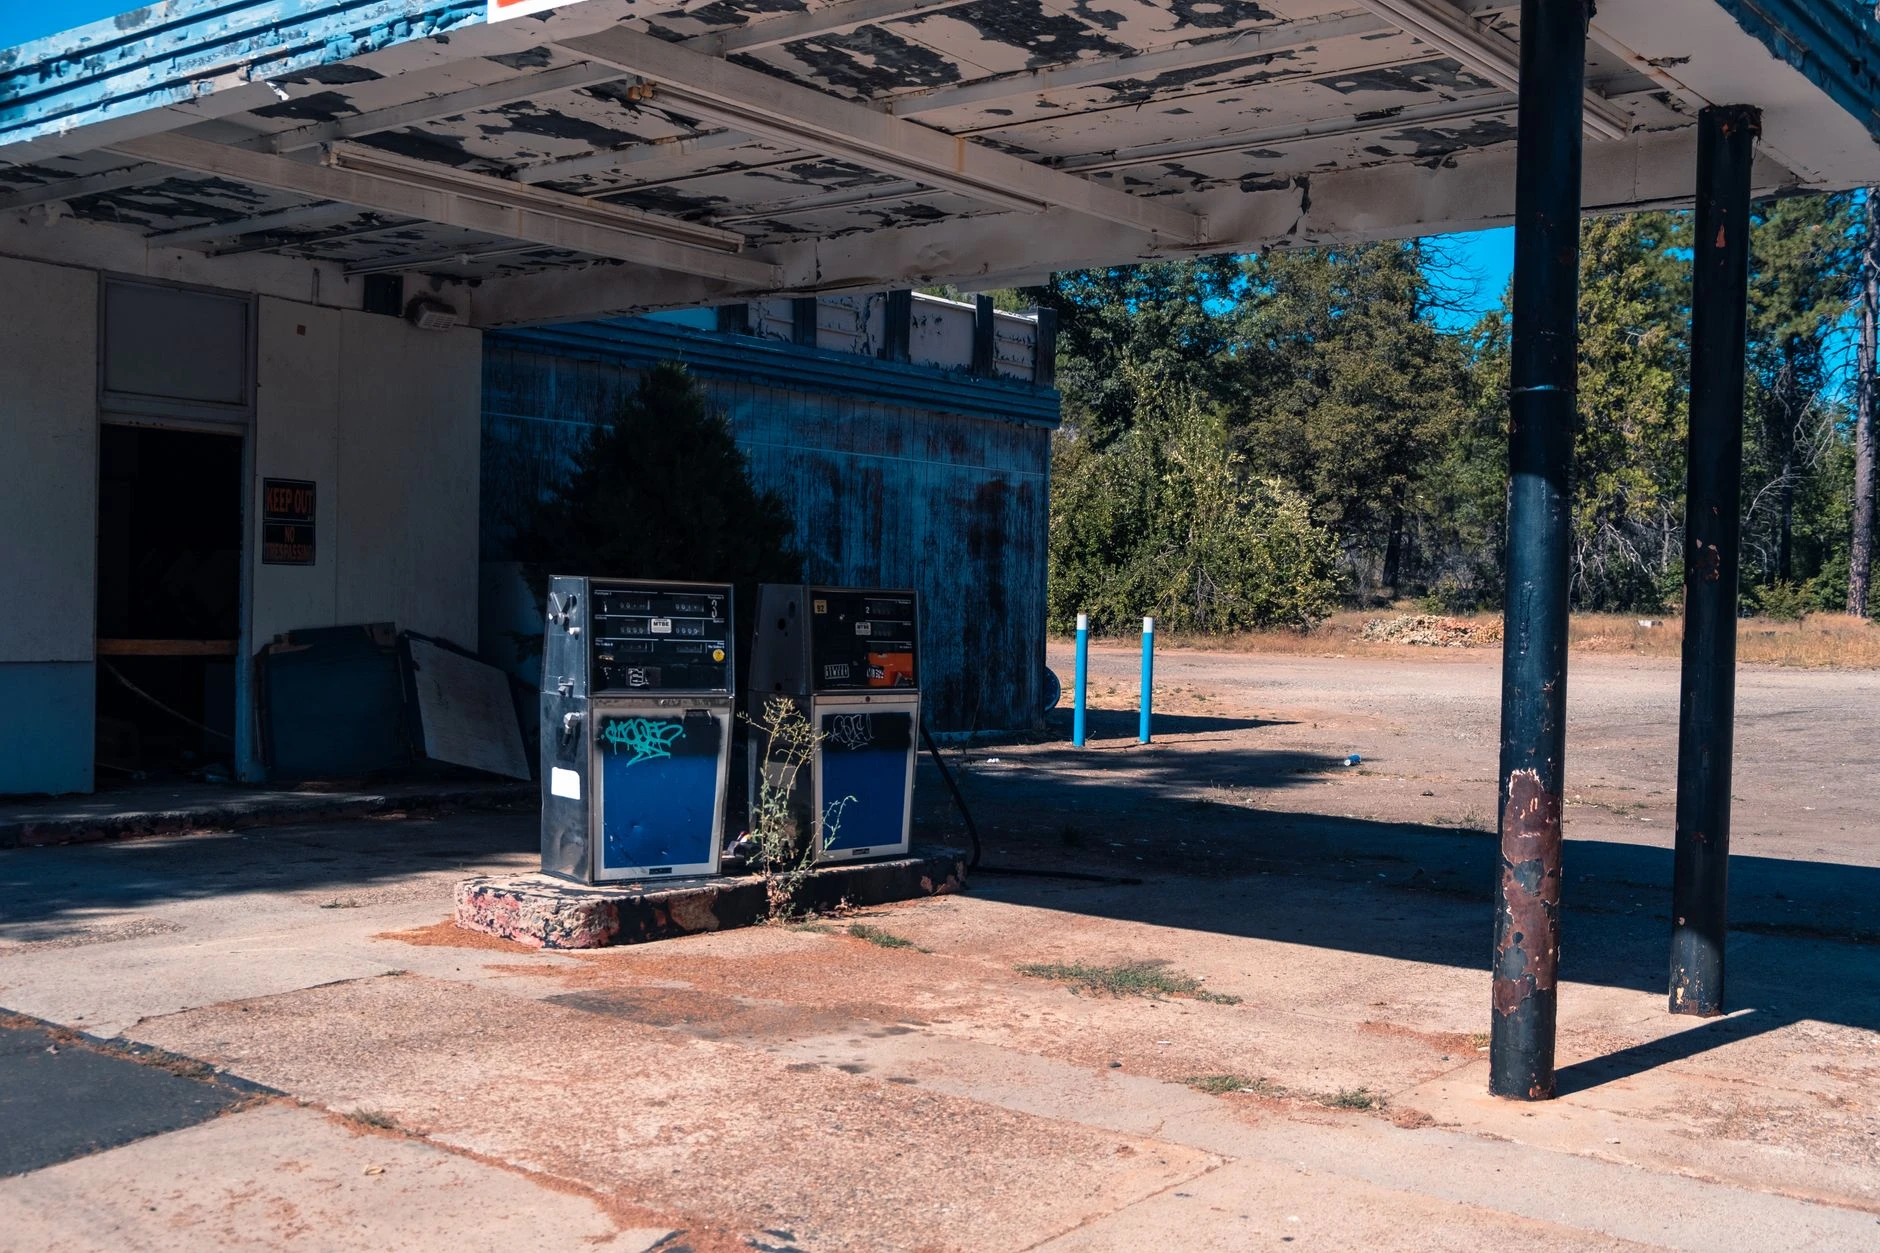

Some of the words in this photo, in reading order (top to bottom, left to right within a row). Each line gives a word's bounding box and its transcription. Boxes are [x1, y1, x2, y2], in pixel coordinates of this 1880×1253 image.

[267, 487, 292, 513] KEEP
[294, 488, 314, 514] OUT
[284, 526, 295, 543] NO
[865, 606, 870, 614] 2
